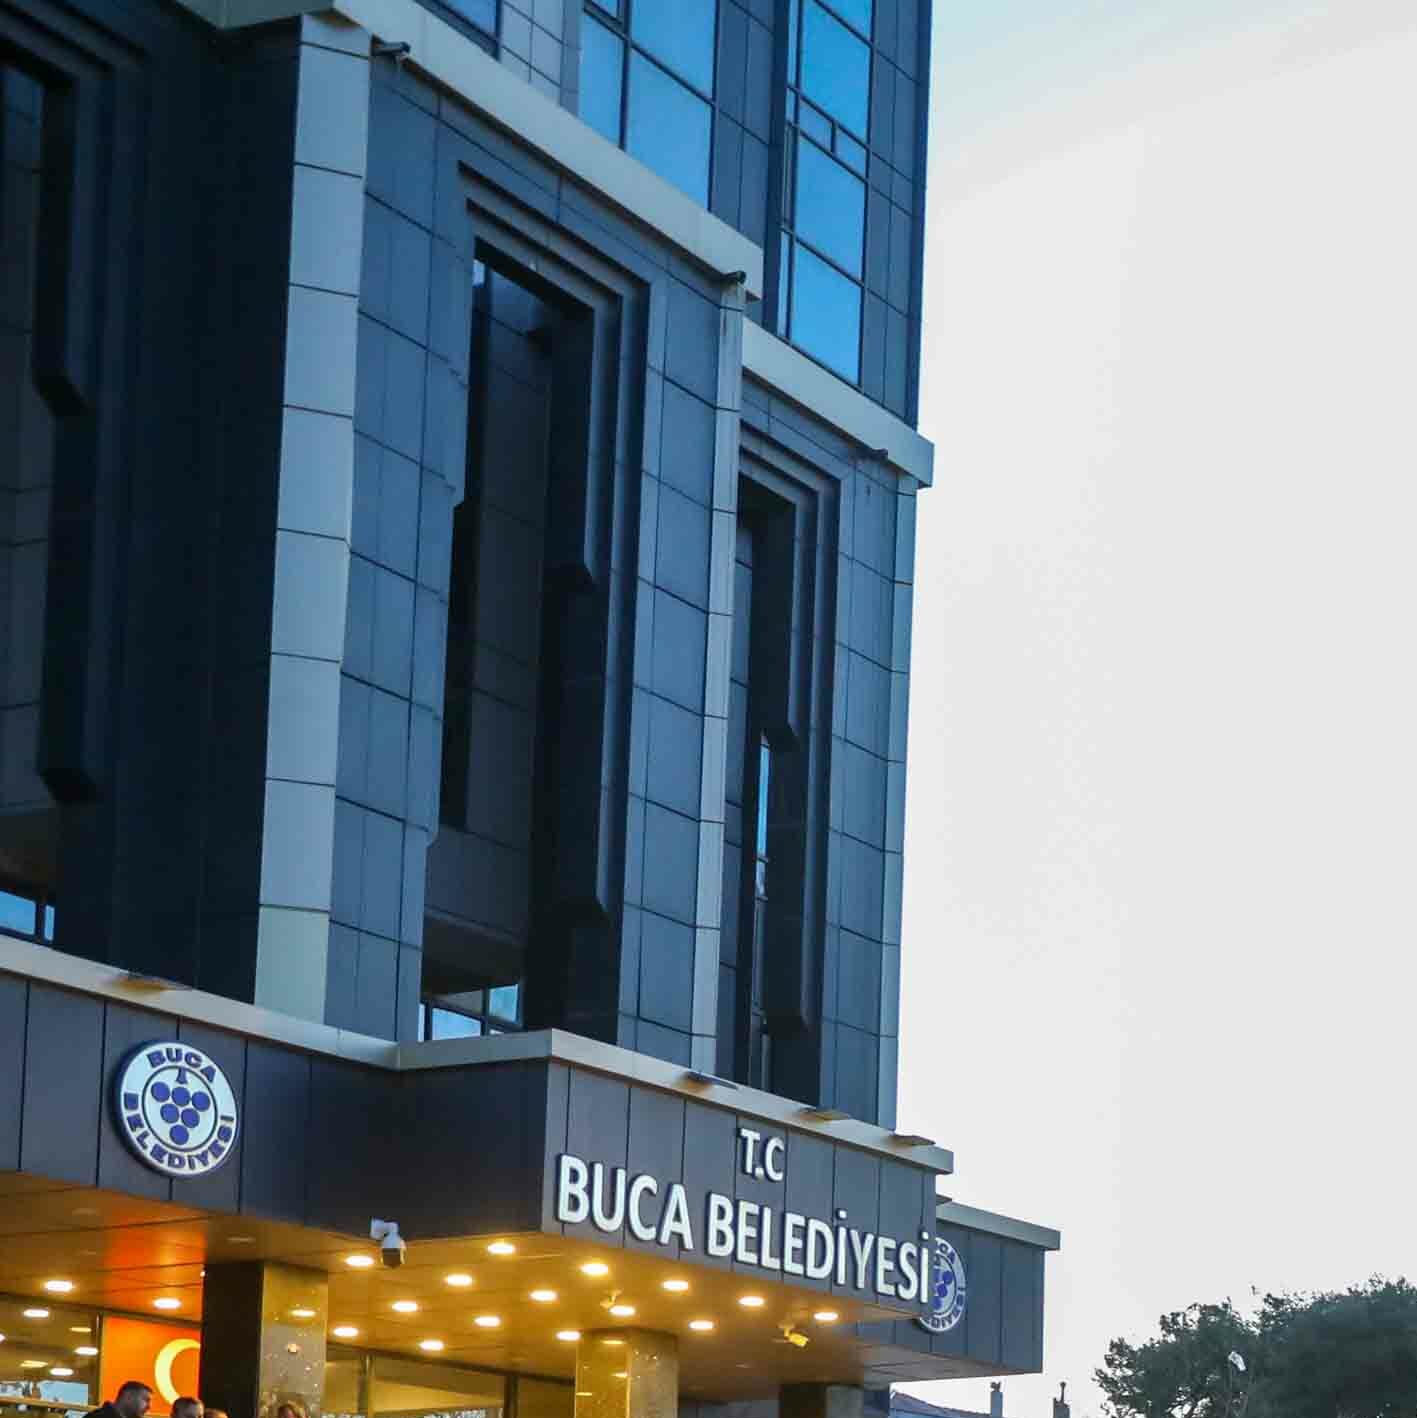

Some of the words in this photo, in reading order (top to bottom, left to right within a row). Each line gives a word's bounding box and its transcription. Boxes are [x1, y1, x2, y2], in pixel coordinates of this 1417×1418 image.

[147, 1048, 216, 1083] BUCA
[740, 1128, 785, 1182] T.C
[557, 1154, 694, 1249] BUCA
[708, 1193, 928, 1304] BELEDİYESİ
